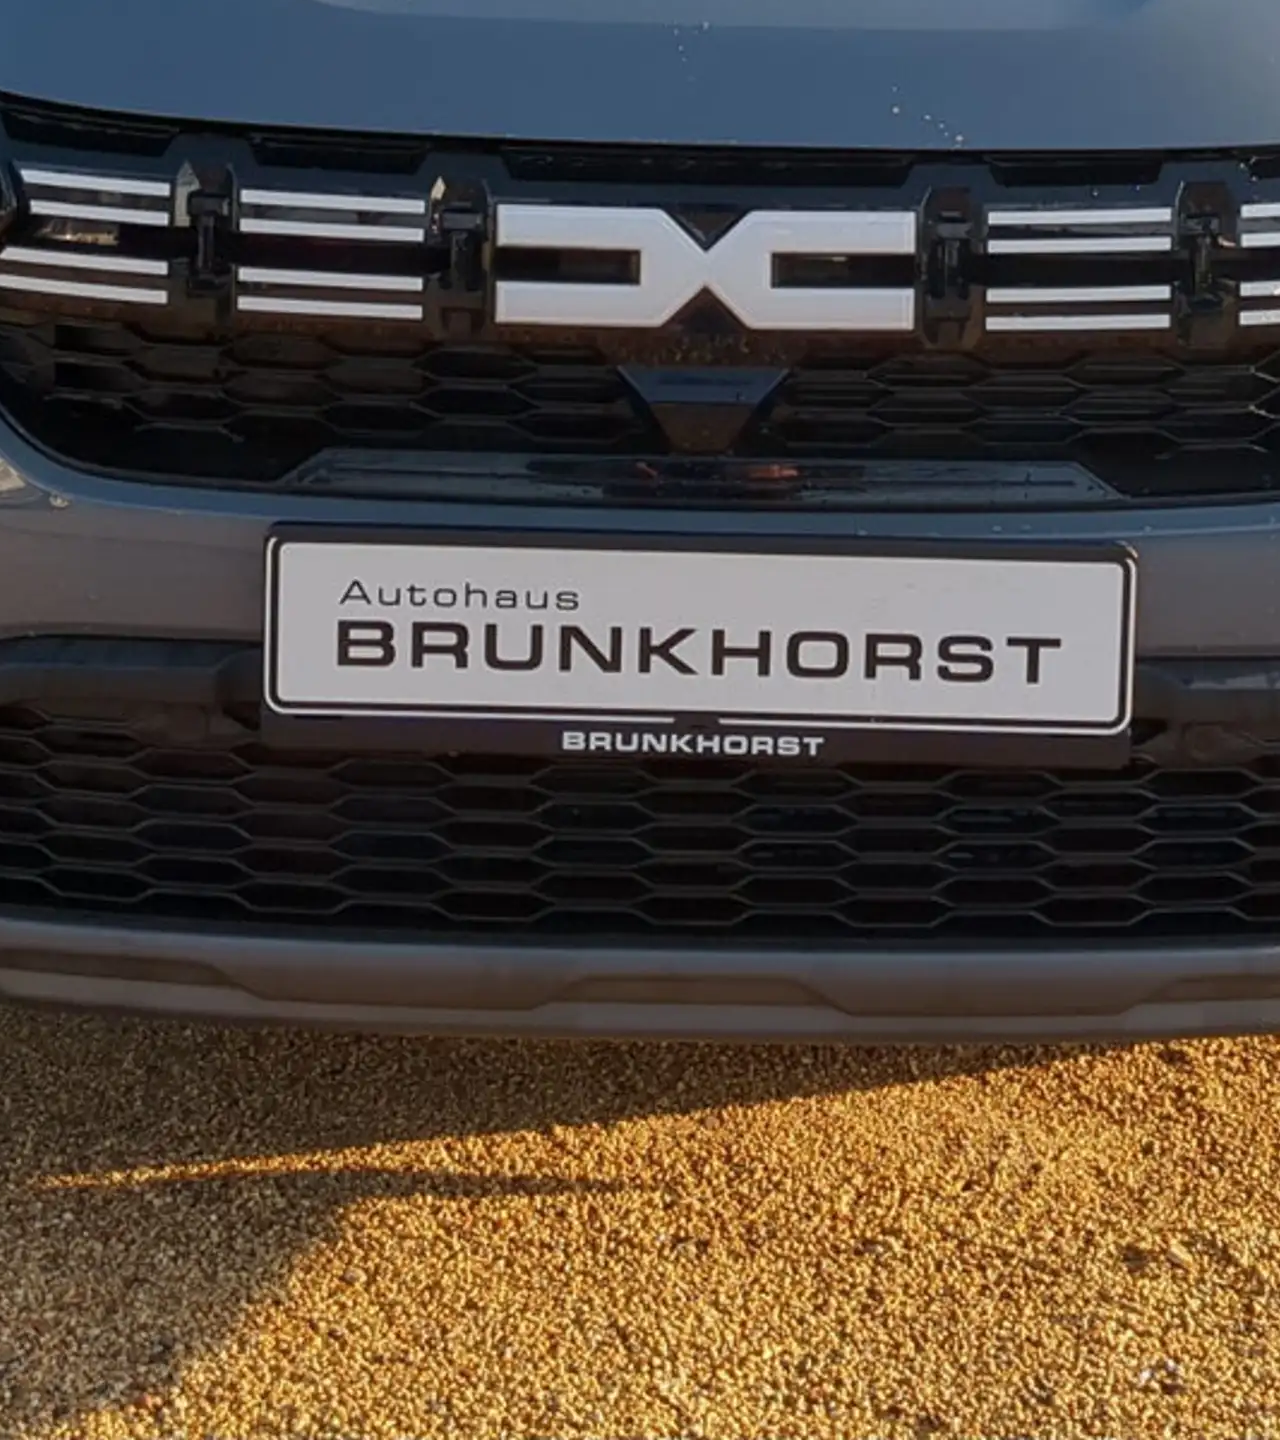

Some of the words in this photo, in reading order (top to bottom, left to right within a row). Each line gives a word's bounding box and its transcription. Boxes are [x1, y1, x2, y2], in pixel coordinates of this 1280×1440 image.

[338, 579, 580, 612] Autohaus
[335, 618, 1063, 686] BRUNKHORST
[560, 729, 825, 758] BRUNKHORST
